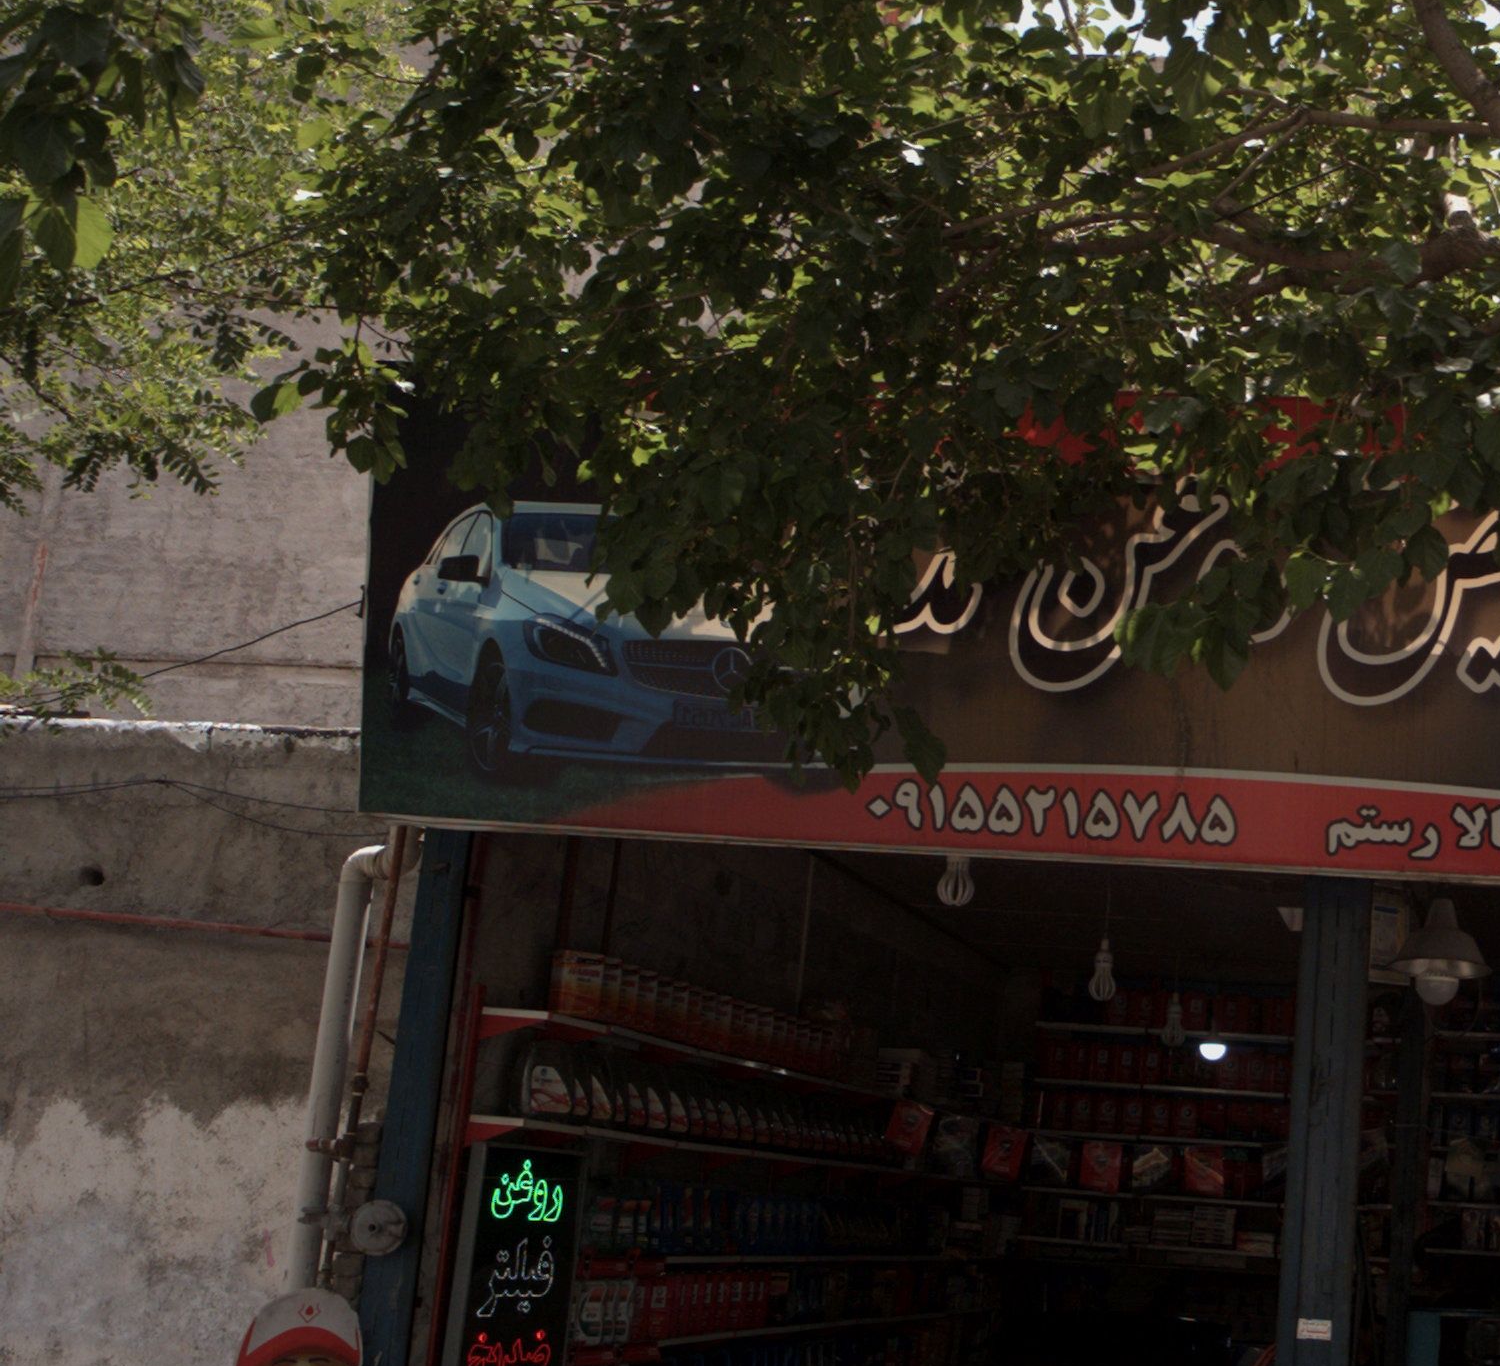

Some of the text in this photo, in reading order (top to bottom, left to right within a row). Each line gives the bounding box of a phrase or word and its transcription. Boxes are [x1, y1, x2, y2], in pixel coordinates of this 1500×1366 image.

[865, 778, 1238, 846] ۰۹۱۵۵۲۱۵۷۸۵
[1326, 805, 1441, 860] رستم
[491, 1158, 564, 1222] روغن
[476, 1235, 554, 1318] فیلتر
